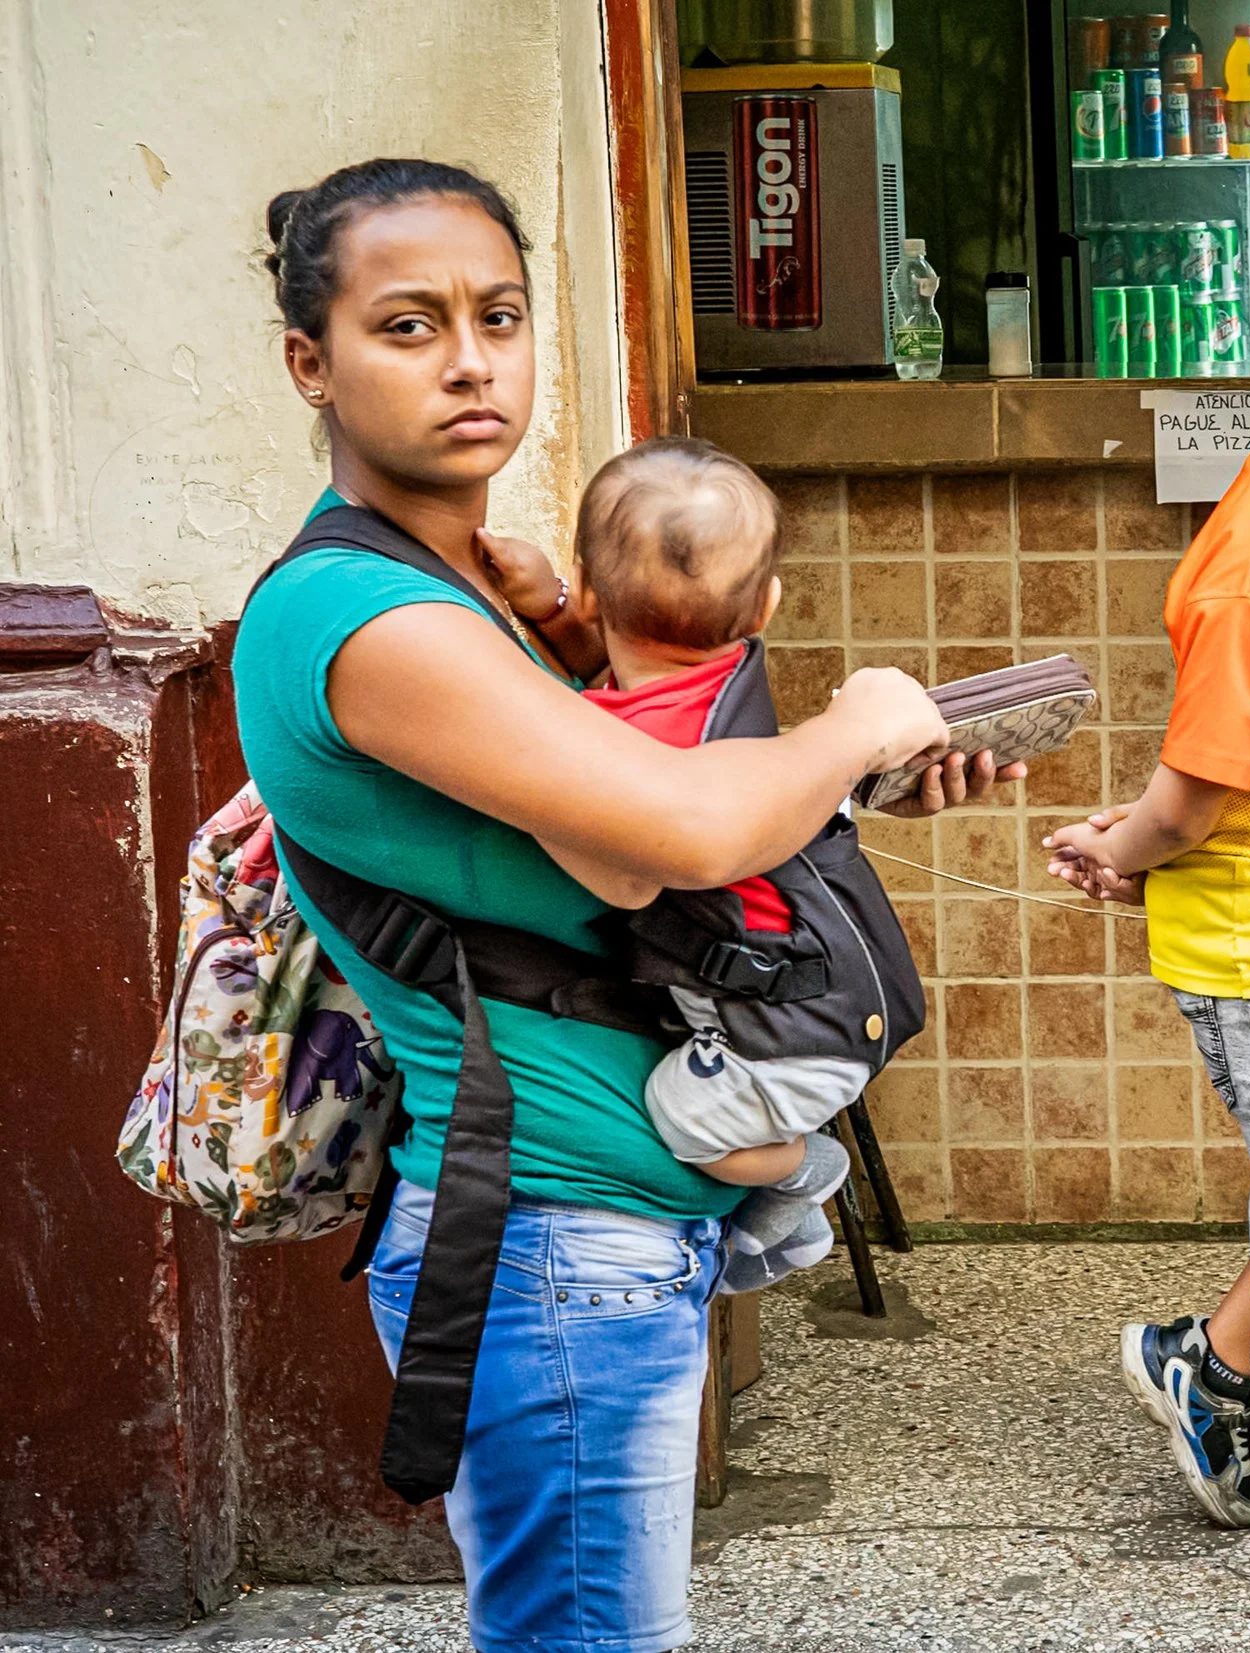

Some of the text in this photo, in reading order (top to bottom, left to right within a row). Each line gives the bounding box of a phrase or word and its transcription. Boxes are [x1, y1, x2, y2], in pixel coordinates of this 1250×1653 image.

[797, 119, 807, 189] ENERGY DRINK
[750, 117, 800, 259] Tigon
[1159, 414, 1221, 431] PAGUE
[1231, 413, 1250, 430] AL
[1177, 436, 1199, 451] LA
